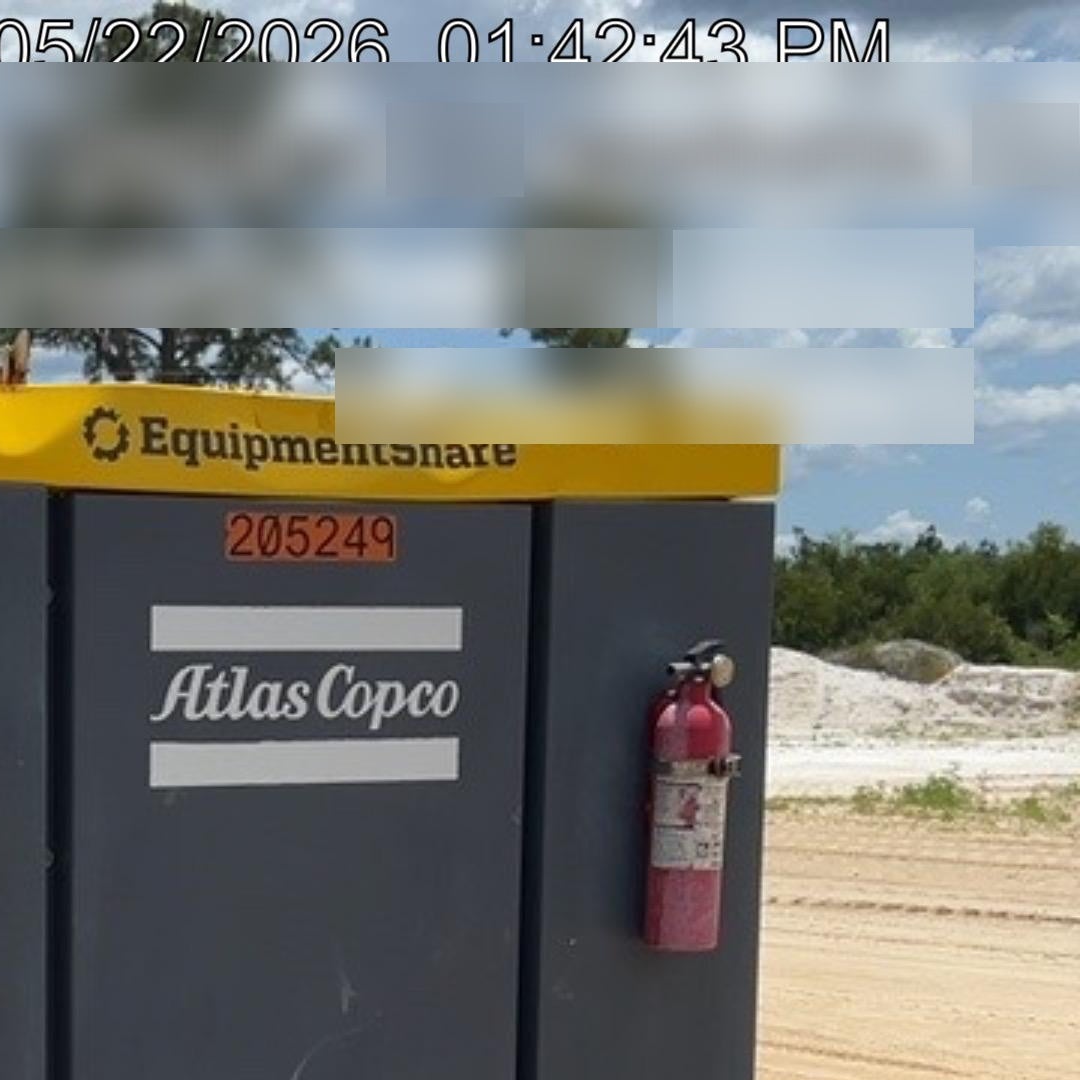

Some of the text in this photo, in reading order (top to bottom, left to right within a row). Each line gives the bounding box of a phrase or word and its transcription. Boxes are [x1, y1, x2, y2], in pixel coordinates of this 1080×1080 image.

[227, 513, 395, 558] 205249
[149, 662, 461, 731] Atlas Copco
